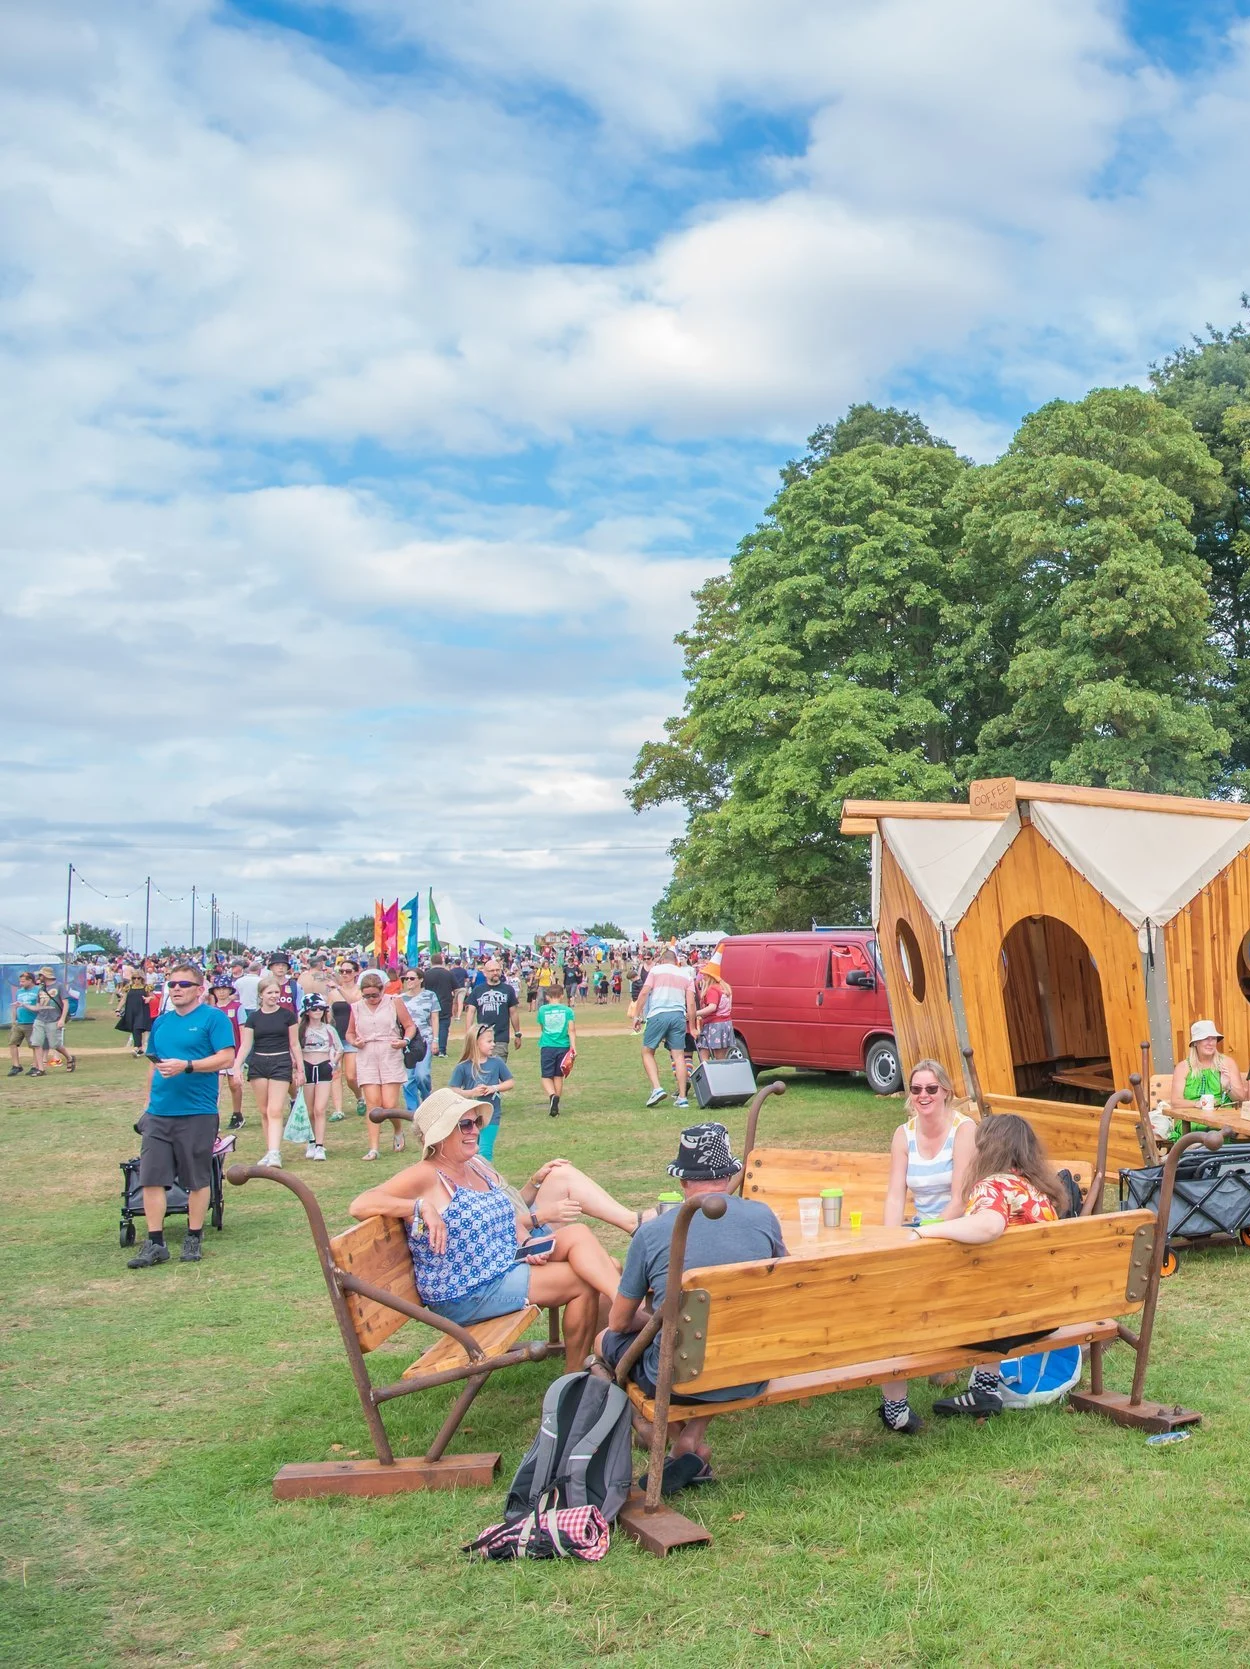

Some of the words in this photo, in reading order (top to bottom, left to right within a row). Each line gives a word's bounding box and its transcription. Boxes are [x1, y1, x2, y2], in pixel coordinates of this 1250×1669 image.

[974, 781, 1009, 807] COFFEE
[990, 799, 1013, 810] MUSIC
[477, 991, 508, 1006] DEATH
